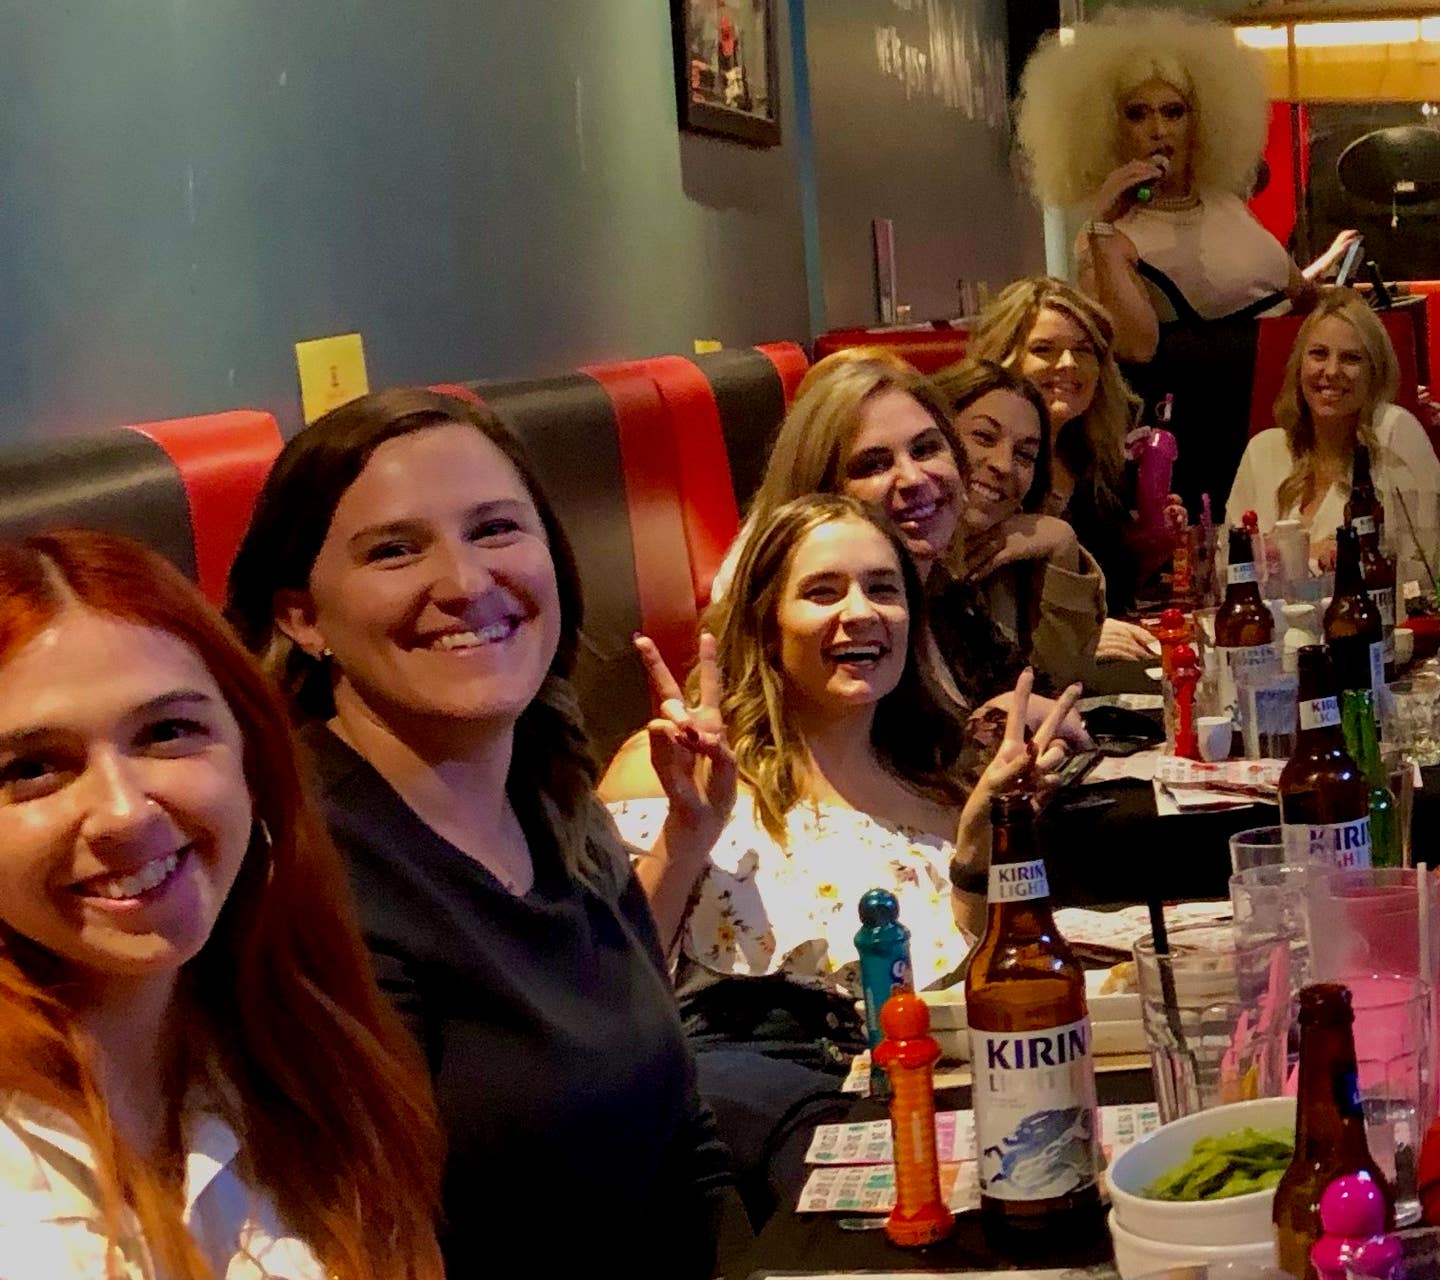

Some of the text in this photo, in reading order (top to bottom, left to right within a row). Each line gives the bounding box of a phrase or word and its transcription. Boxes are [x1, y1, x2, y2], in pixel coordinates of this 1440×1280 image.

[1309, 821, 1371, 854] KIRI
[998, 865, 1046, 884] KIRIN
[986, 1026, 1086, 1069] KIRIN
